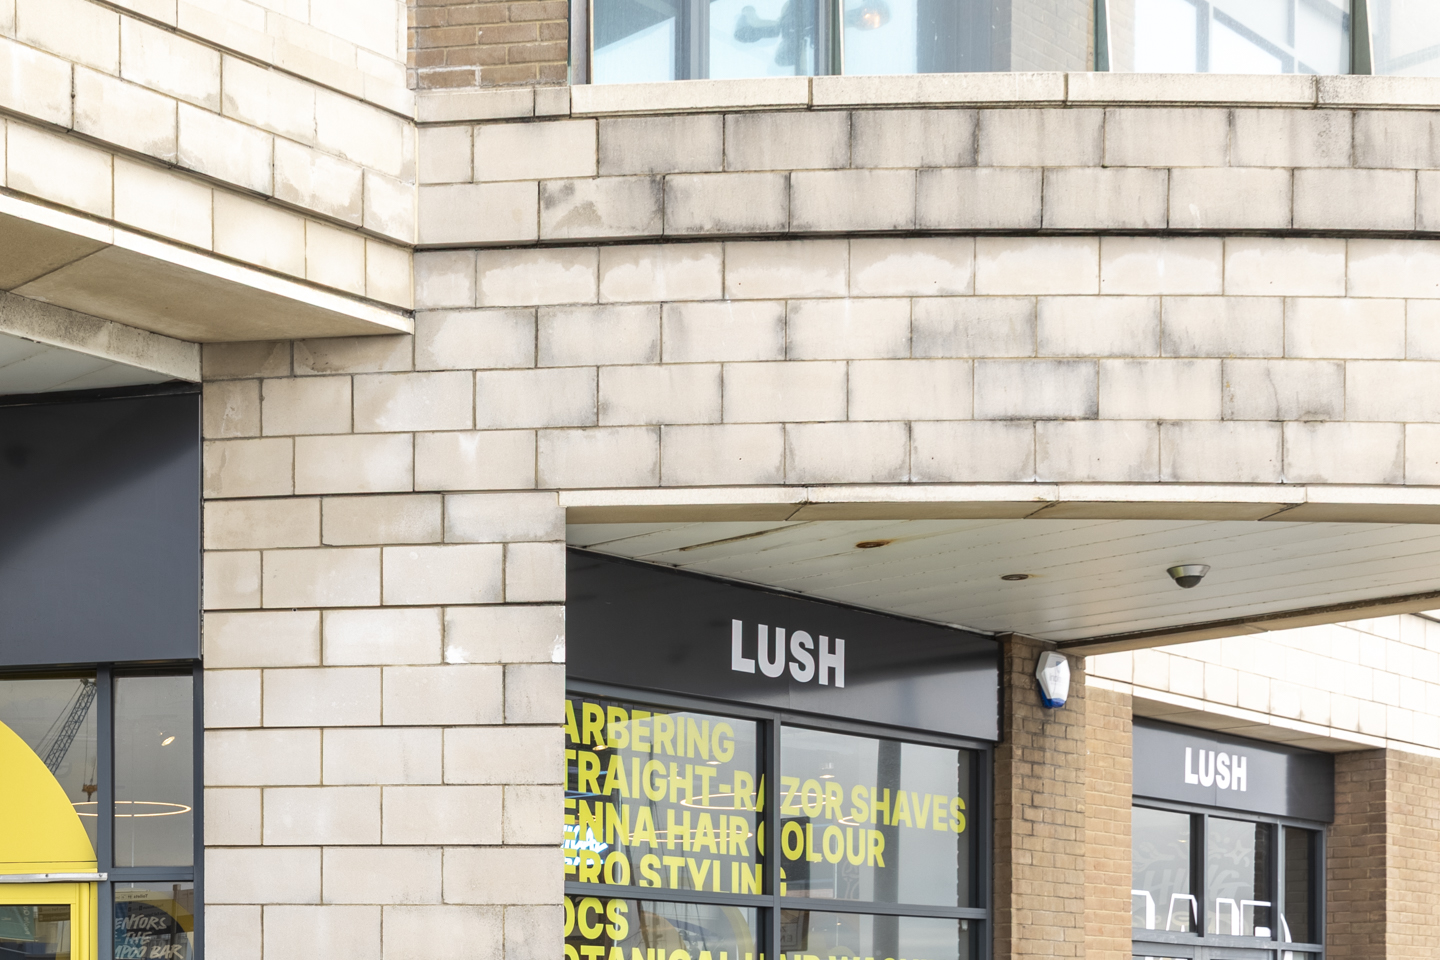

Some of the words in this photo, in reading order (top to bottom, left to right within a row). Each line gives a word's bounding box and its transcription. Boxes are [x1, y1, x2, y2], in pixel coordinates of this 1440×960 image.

[730, 618, 846, 689] LUSH
[563, 748, 844, 820] TRAIGHT-RZOR
[850, 784, 967, 834] SHAVES
[1184, 746, 1248, 792] LUSH
[666, 808, 751, 857] HAIR
[149, 944, 184, 960] BAR
